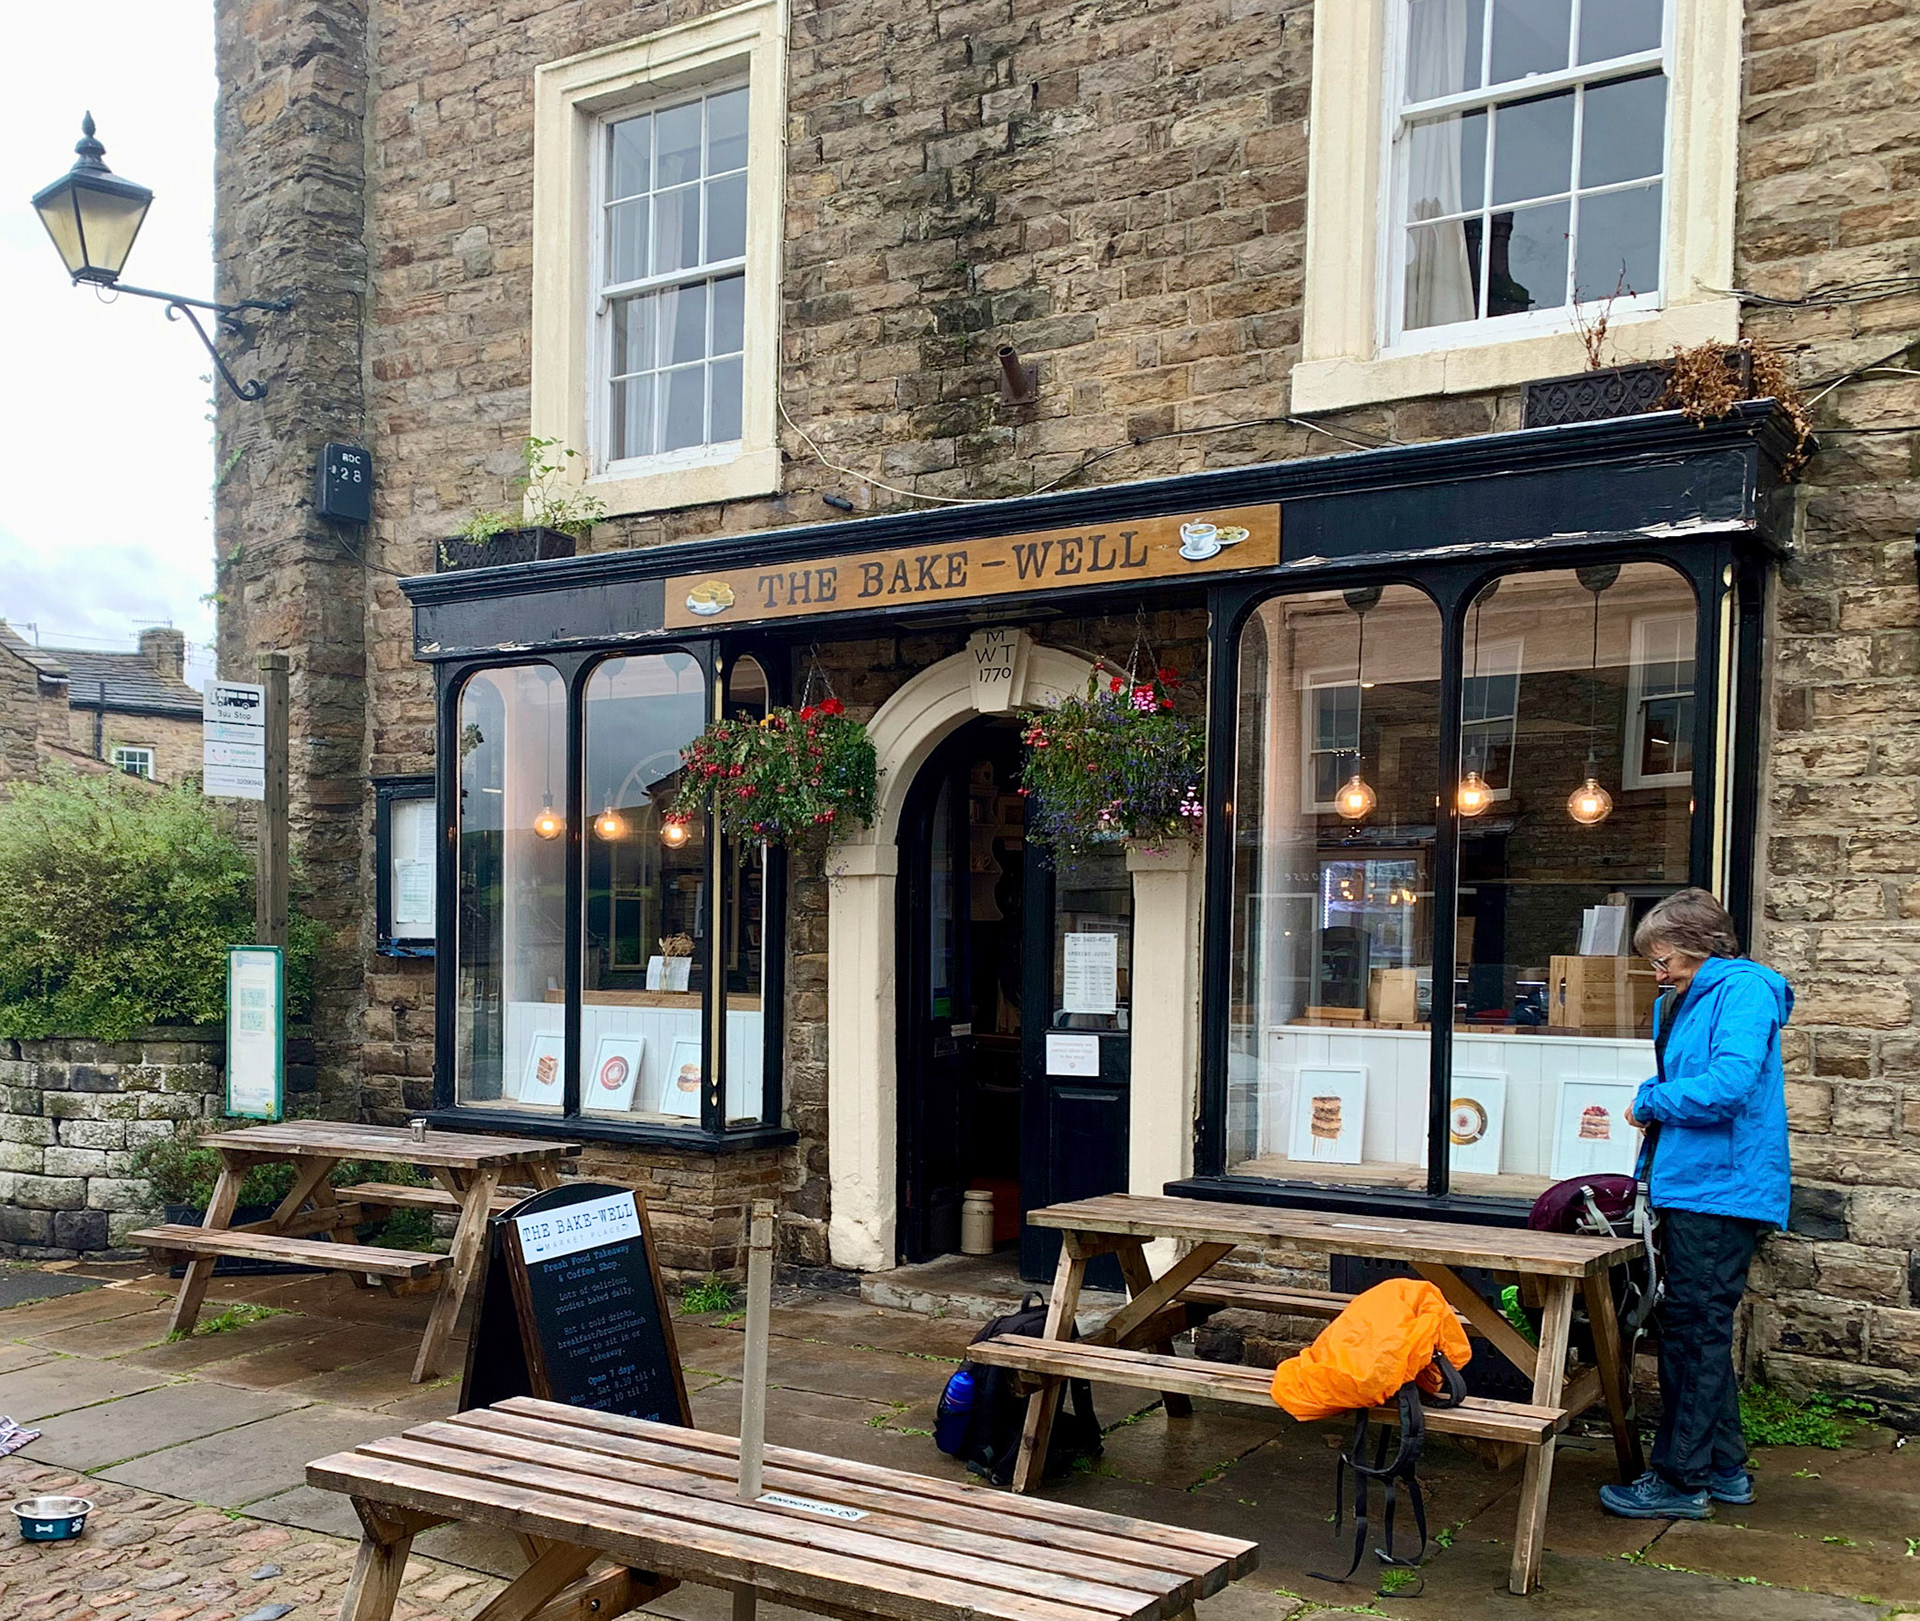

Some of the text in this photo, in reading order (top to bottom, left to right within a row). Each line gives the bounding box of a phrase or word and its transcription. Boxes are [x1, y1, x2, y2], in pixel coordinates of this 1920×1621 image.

[342, 453, 361, 465] RDC
[757, 566, 838, 609] THE
[986, 630, 1004, 644] M
[979, 666, 1012, 683] 1770
[233, 711, 252, 720] Stop
[522, 1203, 633, 1242] THE BAKE-WELL
[545, 1225, 621, 1249] MARKET PLACE
[543, 1245, 630, 1273] Fresh Food Takeaway
[566, 1267, 596, 1280] Coffee
[559, 1290, 577, 1301] Lots
[591, 1276, 628, 1292] delicious
[555, 1300, 585, 1316] goodies
[587, 1293, 610, 1305] baked
[588, 1316, 606, 1329] cold
[593, 1342, 603, 1351] to
[605, 1336, 619, 1347] sit
[621, 1333, 630, 1342] in
[632, 1330, 641, 1338] or
[588, 1364, 636, 1386] Open 7 days
[597, 1385, 611, 1395] Sat
[634, 1371, 649, 1382] til
[614, 1392, 624, 1402] 10
[627, 1386, 641, 1398] til
[643, 1383, 649, 1392] 3
